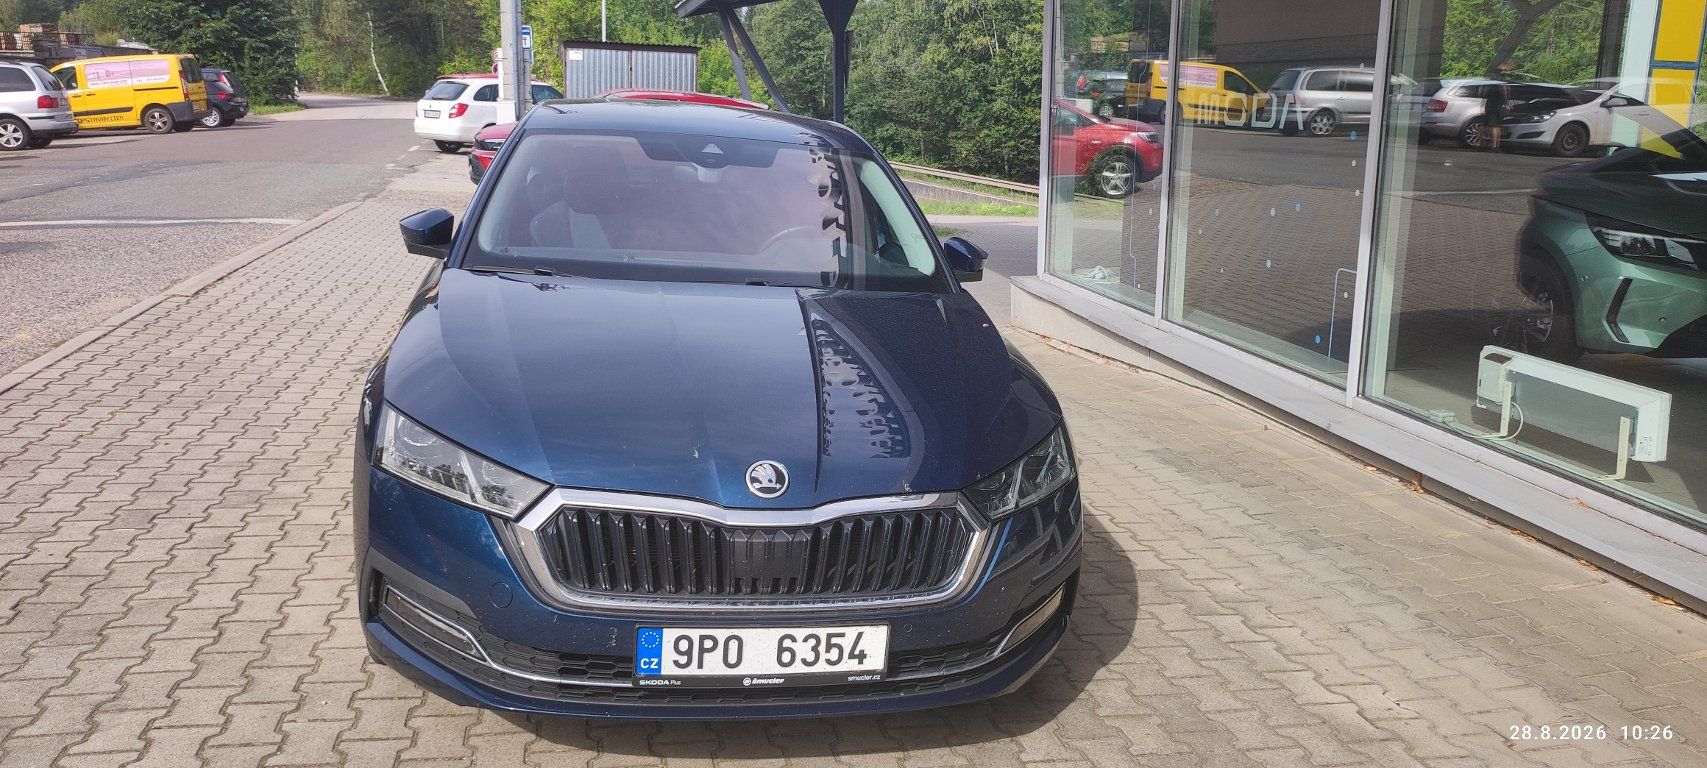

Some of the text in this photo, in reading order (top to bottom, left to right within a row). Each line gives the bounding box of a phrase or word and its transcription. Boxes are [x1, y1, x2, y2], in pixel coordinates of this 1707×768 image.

[672, 631, 868, 669] 9P0 6354
[640, 658, 659, 669] CZ
